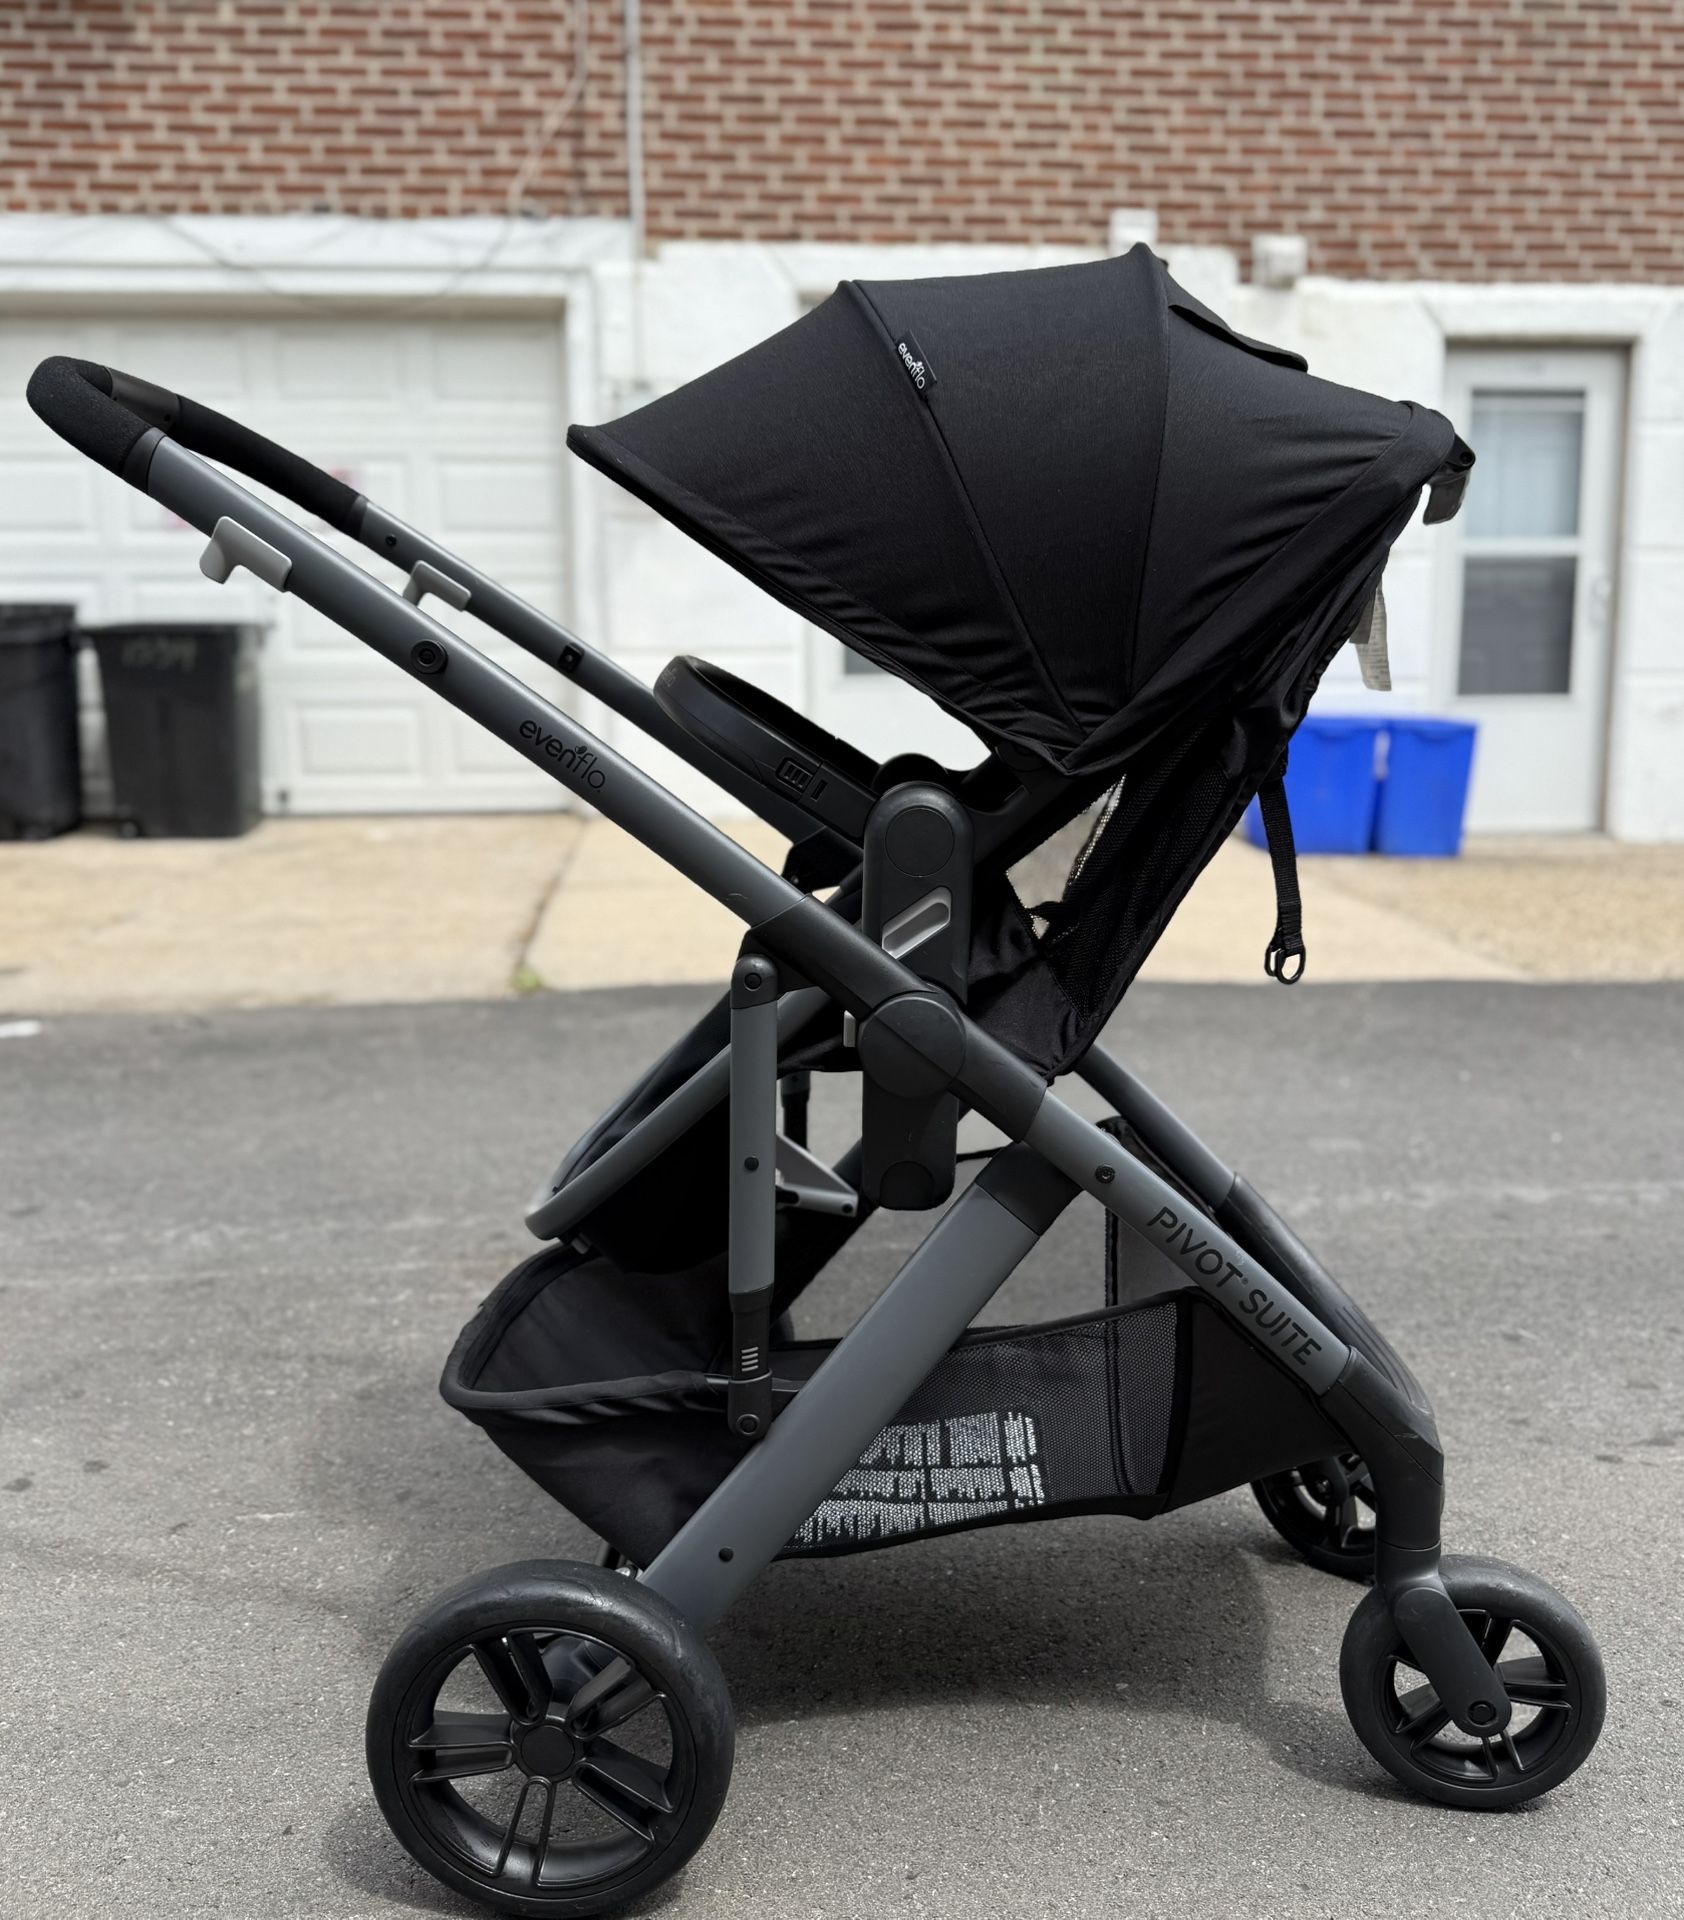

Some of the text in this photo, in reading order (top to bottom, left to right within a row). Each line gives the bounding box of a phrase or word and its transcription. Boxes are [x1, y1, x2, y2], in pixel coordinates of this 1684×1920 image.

[898, 342, 925, 389] evenflo
[519, 720, 606, 789] evenflo
[1147, 1206, 1322, 1366] PIVOT SUITE
